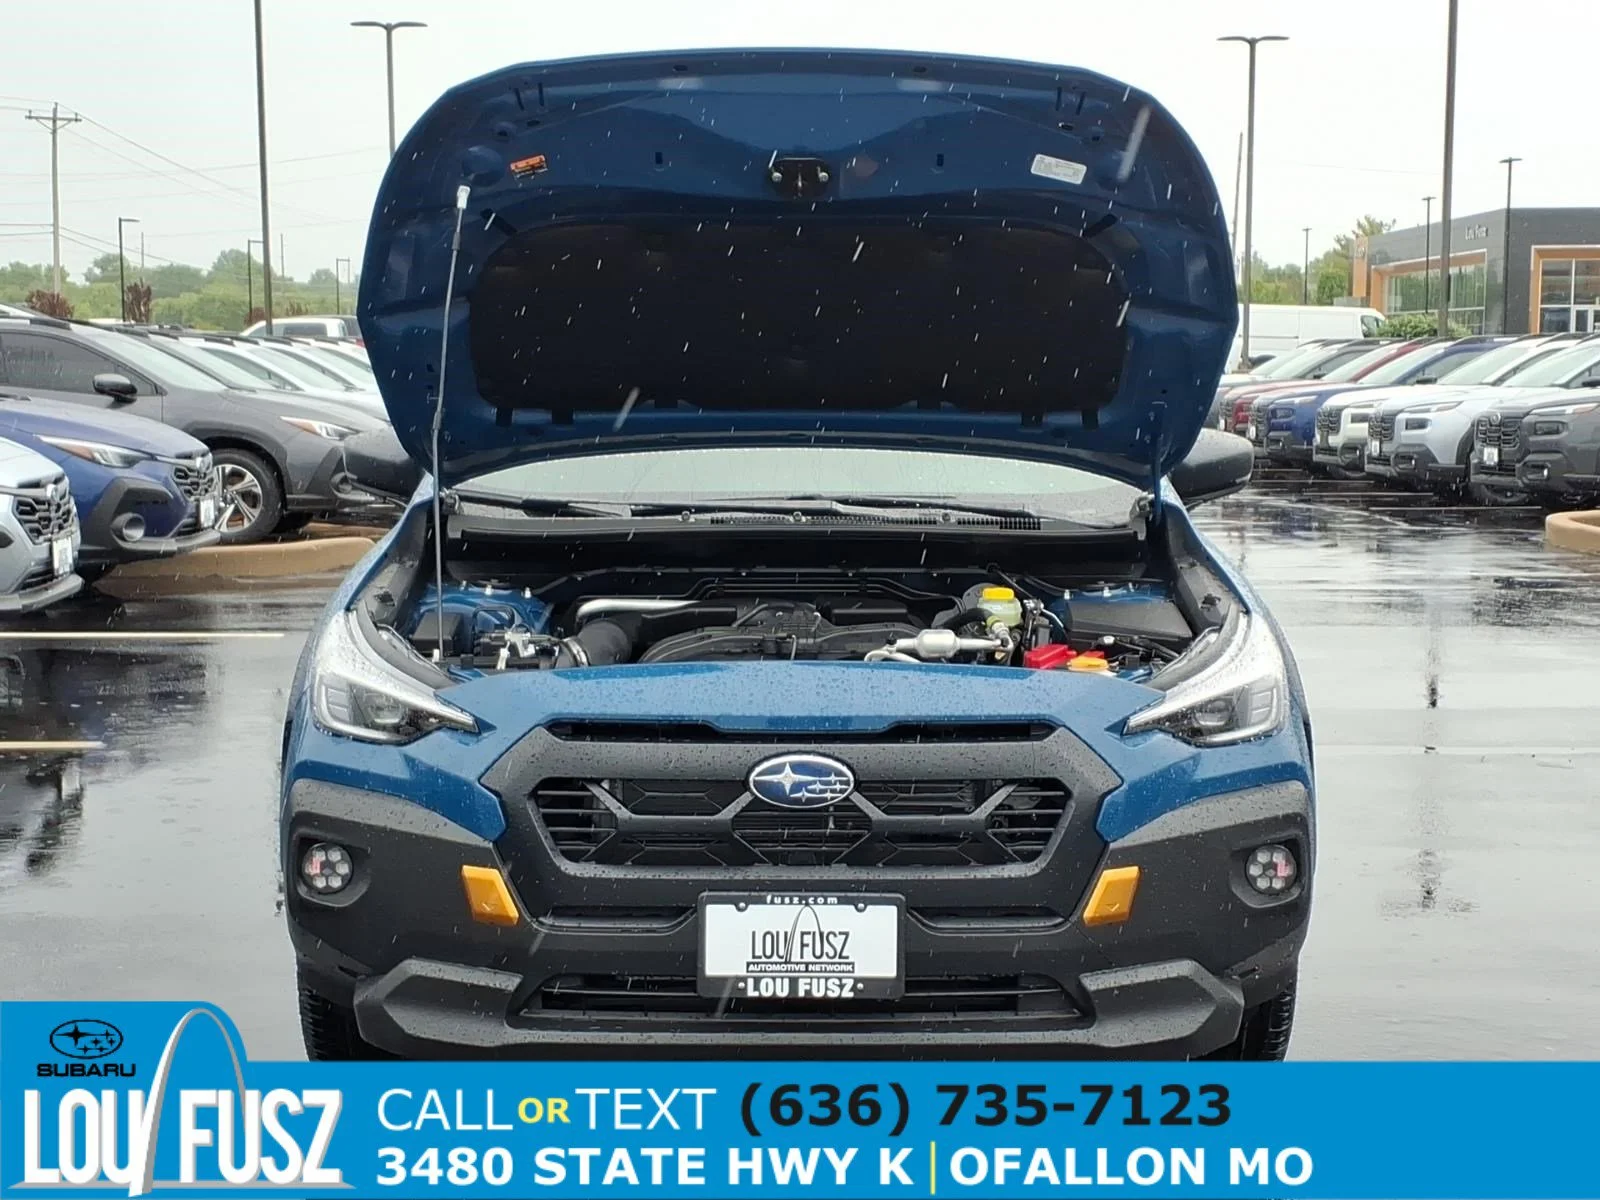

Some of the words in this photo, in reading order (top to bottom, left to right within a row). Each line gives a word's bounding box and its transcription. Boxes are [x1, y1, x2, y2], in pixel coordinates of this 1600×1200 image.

[766, 895, 838, 905] fusz.com
[751, 930, 787, 960] LOU
[800, 930, 850, 960] FUSZ
[748, 963, 806, 973] AUTOMOTIVE
[808, 963, 854, 973] NETWORK
[747, 977, 790, 998] LOU
[798, 977, 855, 998] FUSZ
